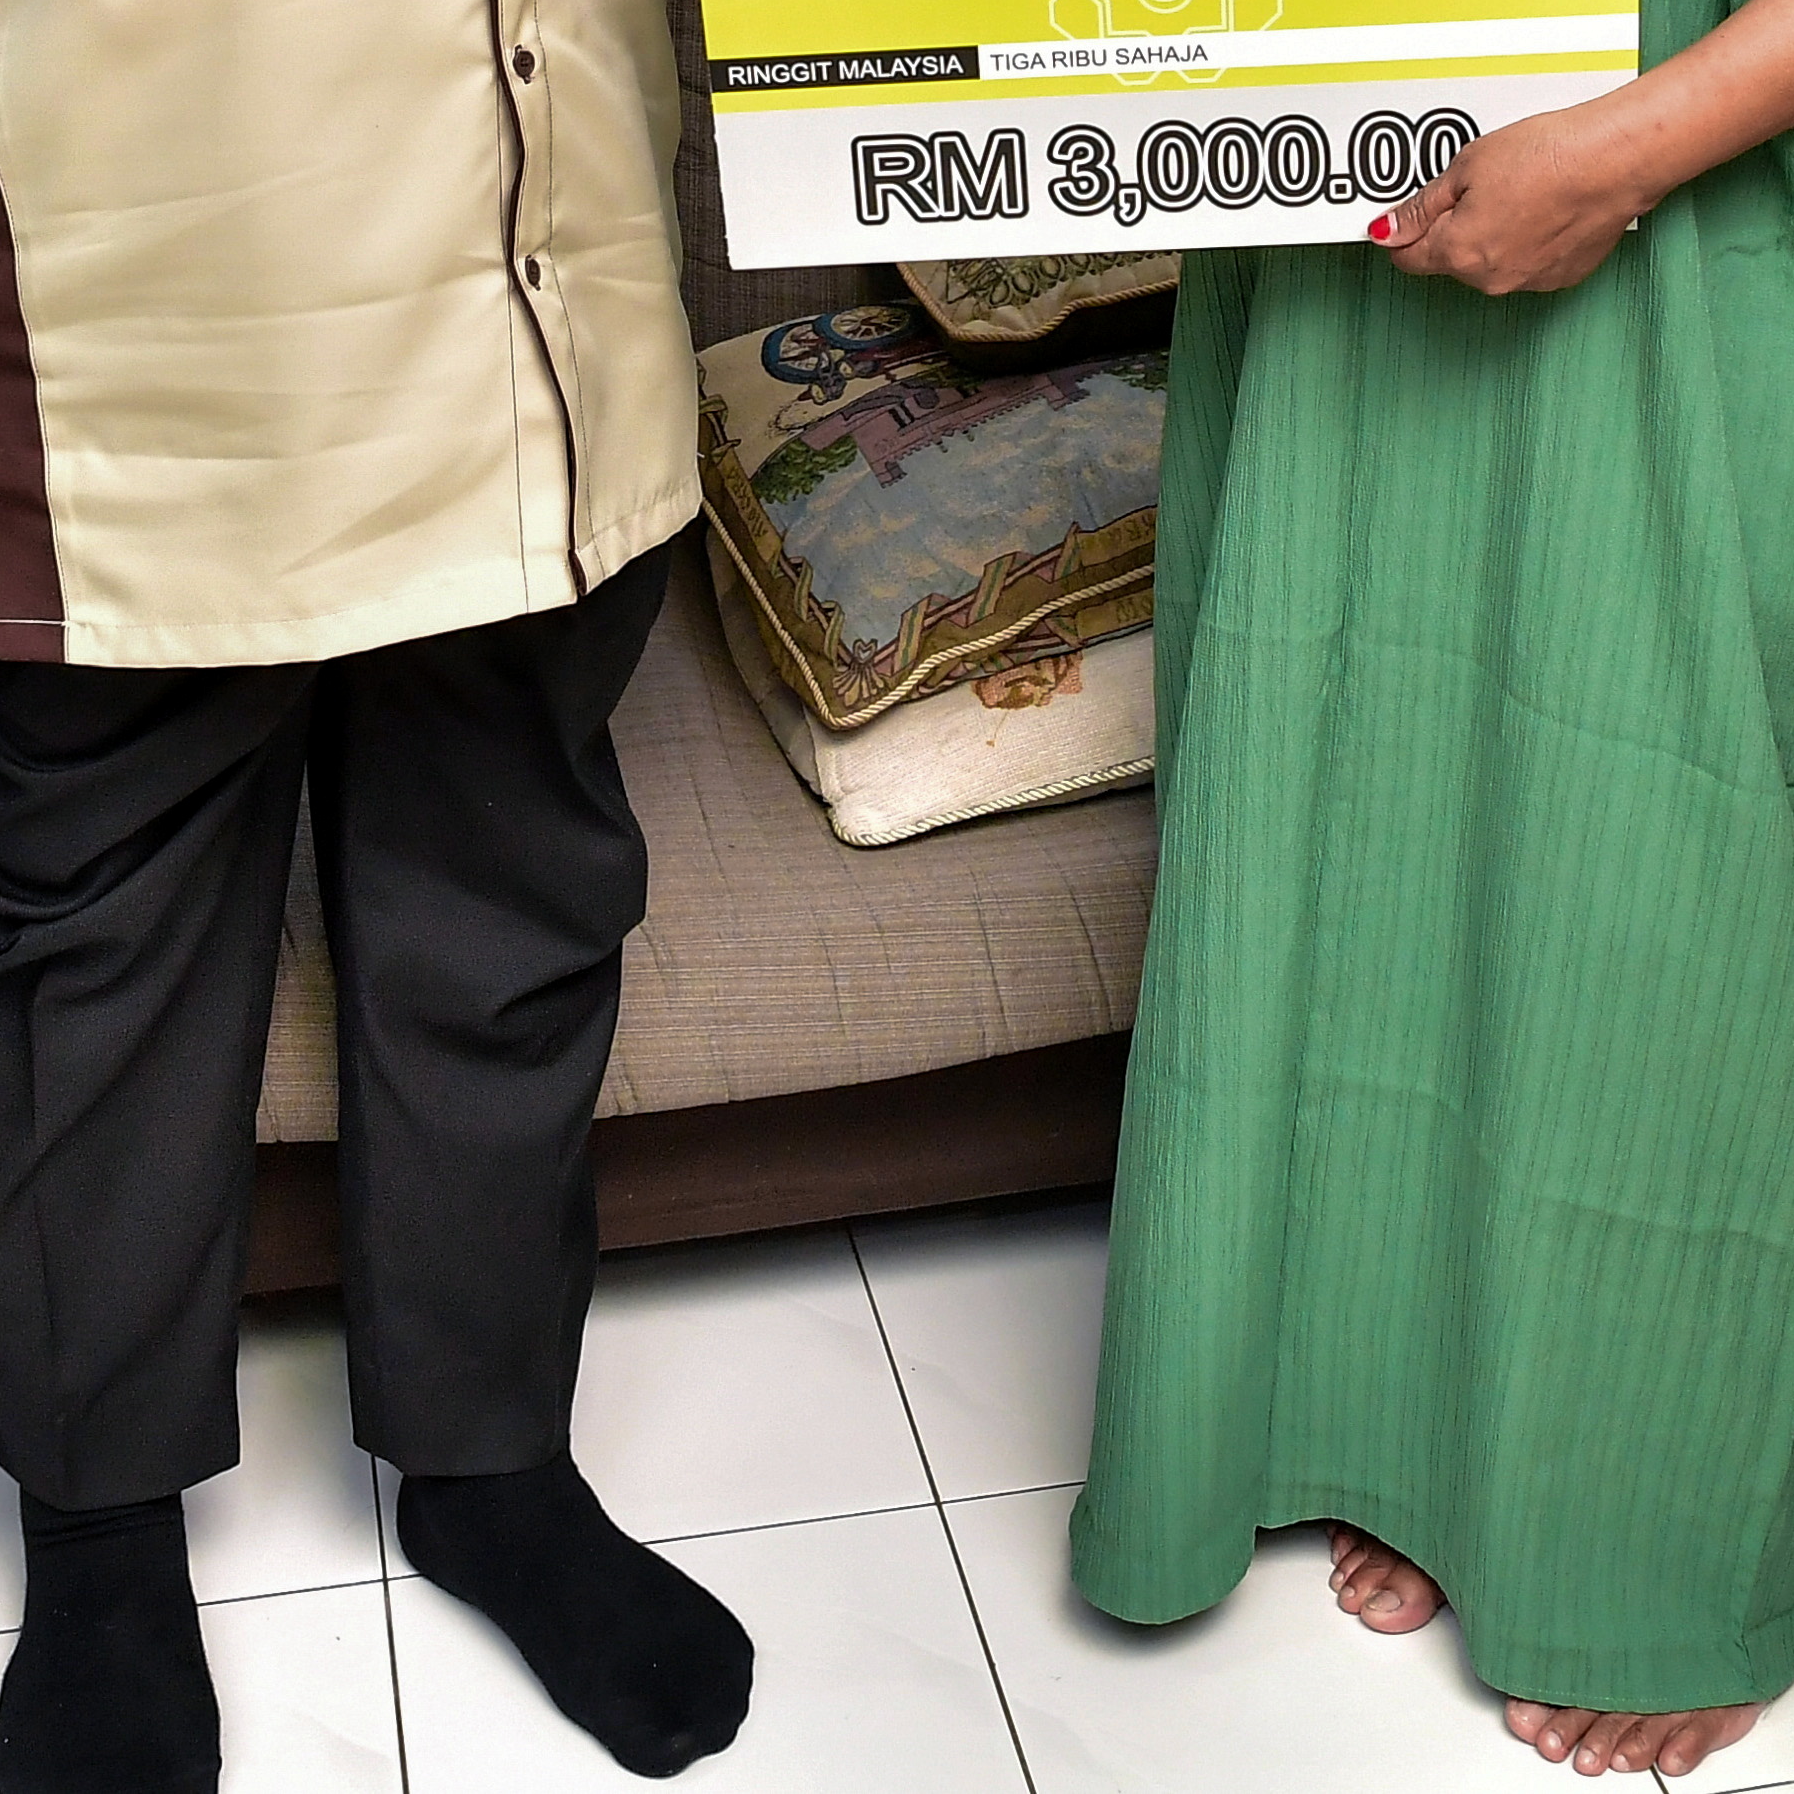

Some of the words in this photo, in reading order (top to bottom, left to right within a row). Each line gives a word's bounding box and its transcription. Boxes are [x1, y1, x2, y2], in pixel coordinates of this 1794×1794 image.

[728, 60, 832, 87] RINGGIT
[839, 55, 964, 81] MALAYSIA
[990, 52, 1046, 72] TIGA
[1052, 48, 1108, 69] RIBU
[1114, 44, 1209, 67] SAHAJA
[851, 127, 1029, 225] RM
[1046, 108, 1481, 227] 3,000.00
